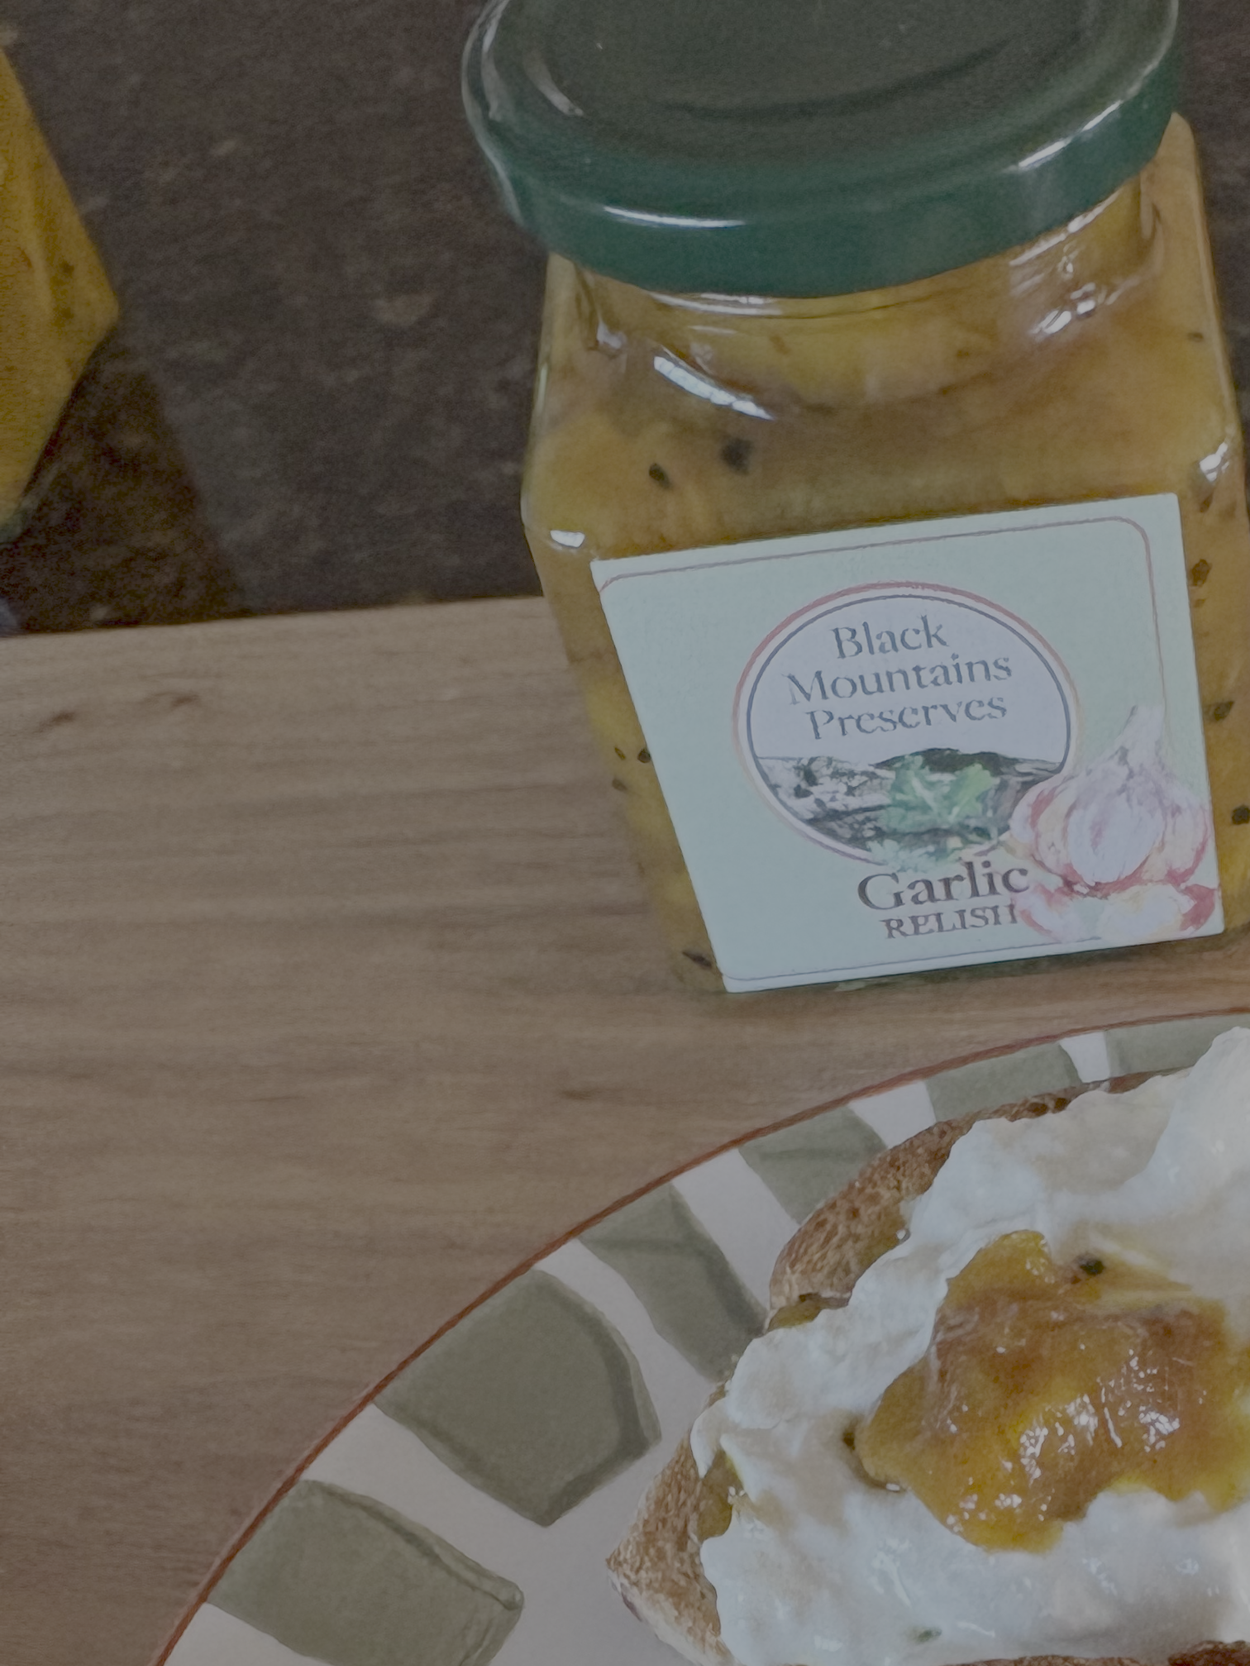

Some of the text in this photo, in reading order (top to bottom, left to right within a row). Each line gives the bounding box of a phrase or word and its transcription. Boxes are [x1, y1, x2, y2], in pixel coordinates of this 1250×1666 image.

[830, 614, 950, 660] Black
[785, 653, 1013, 705] Mountains
[805, 695, 1008, 740] Preserves
[857, 859, 1031, 912] Garlic
[883, 904, 1019, 939] RELISH
